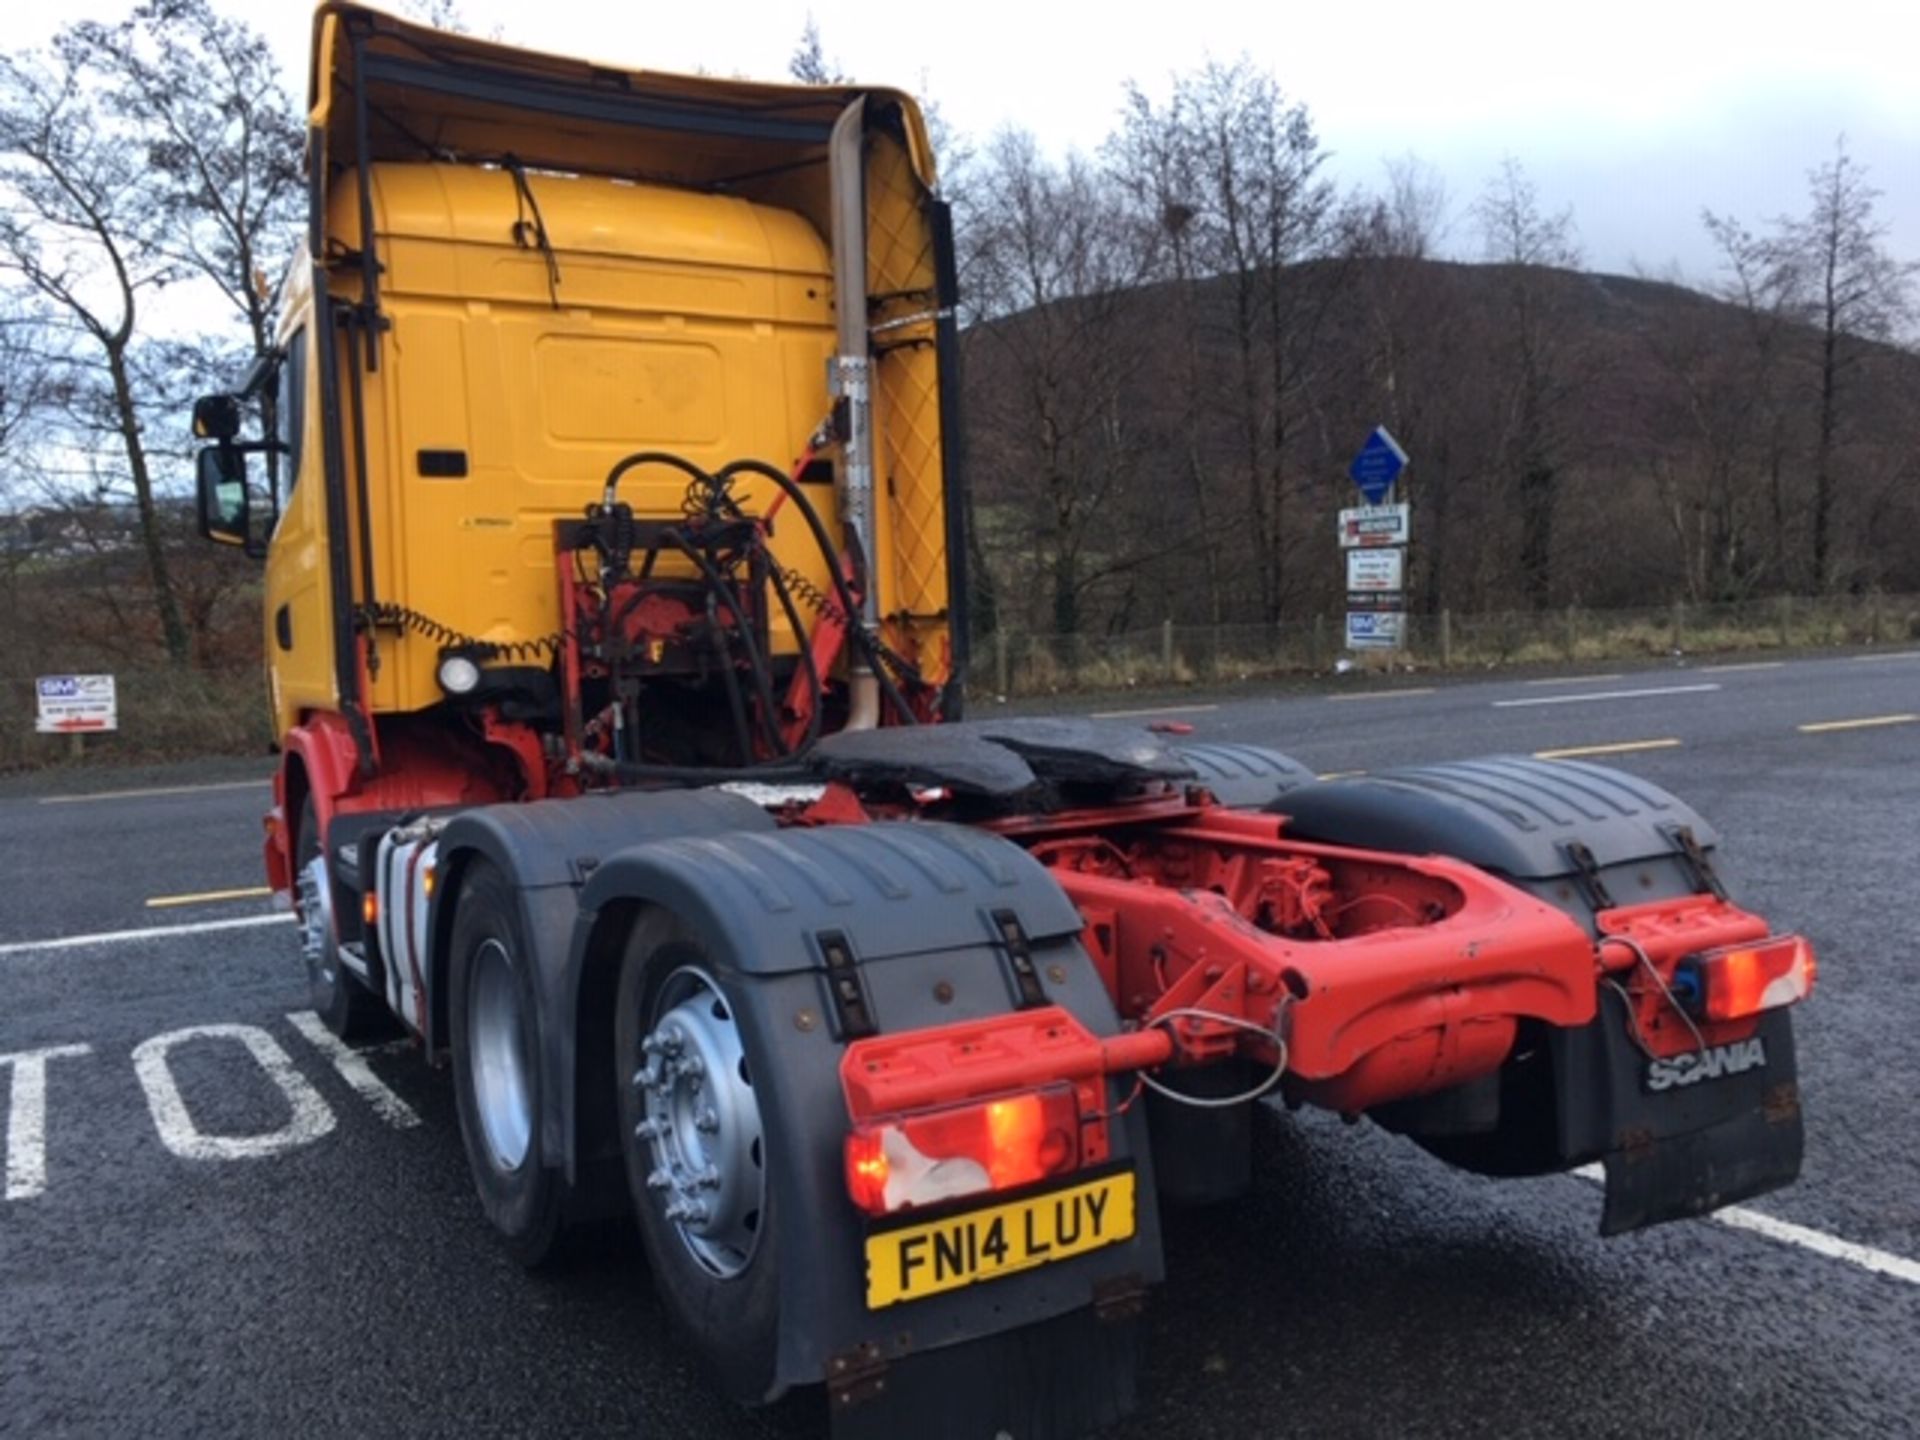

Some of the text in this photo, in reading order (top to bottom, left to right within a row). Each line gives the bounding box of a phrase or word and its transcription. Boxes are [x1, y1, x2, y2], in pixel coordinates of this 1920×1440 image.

[1647, 1037, 1767, 1091] SCANIA
[898, 1187, 1109, 1291] FN14 LUY
